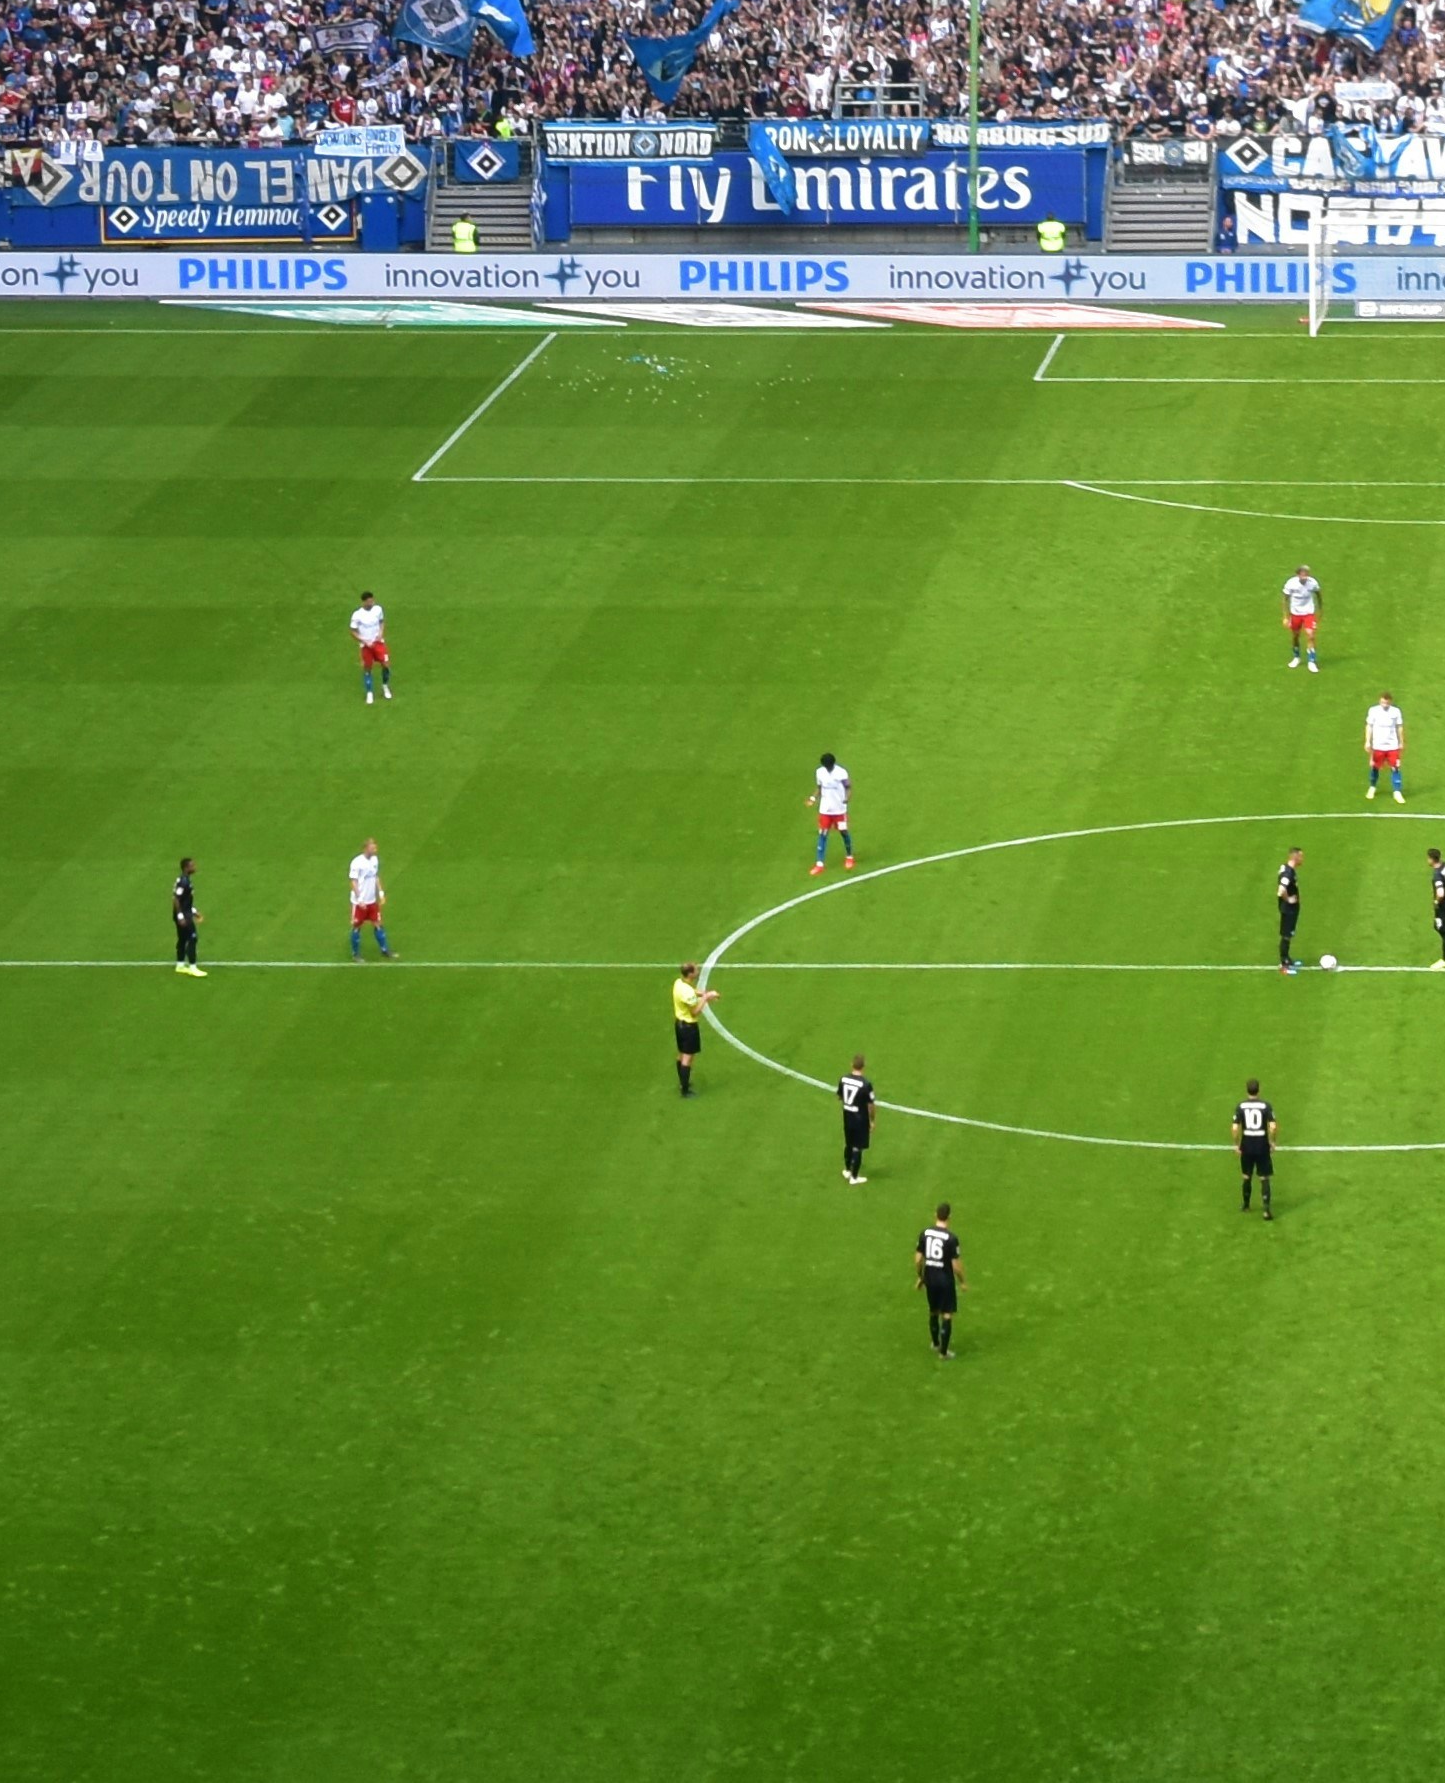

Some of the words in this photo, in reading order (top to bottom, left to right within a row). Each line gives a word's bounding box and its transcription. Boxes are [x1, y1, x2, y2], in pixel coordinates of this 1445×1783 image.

[546, 130, 630, 157] SEKTION
[659, 130, 714, 156] NORD
[835, 124, 924, 151] LOYALTY
[625, 165, 732, 224] Fly
[142, 205, 212, 234] Speedy
[83, 266, 140, 293] you
[178, 259, 348, 290] PHILIPS
[385, 263, 539, 289] innovation
[584, 266, 641, 294] you
[679, 260, 850, 292] PHILIPS
[889, 264, 1045, 290] innovation
[1090, 269, 1146, 296] you
[1186, 262, 1356, 294] PHILIS
